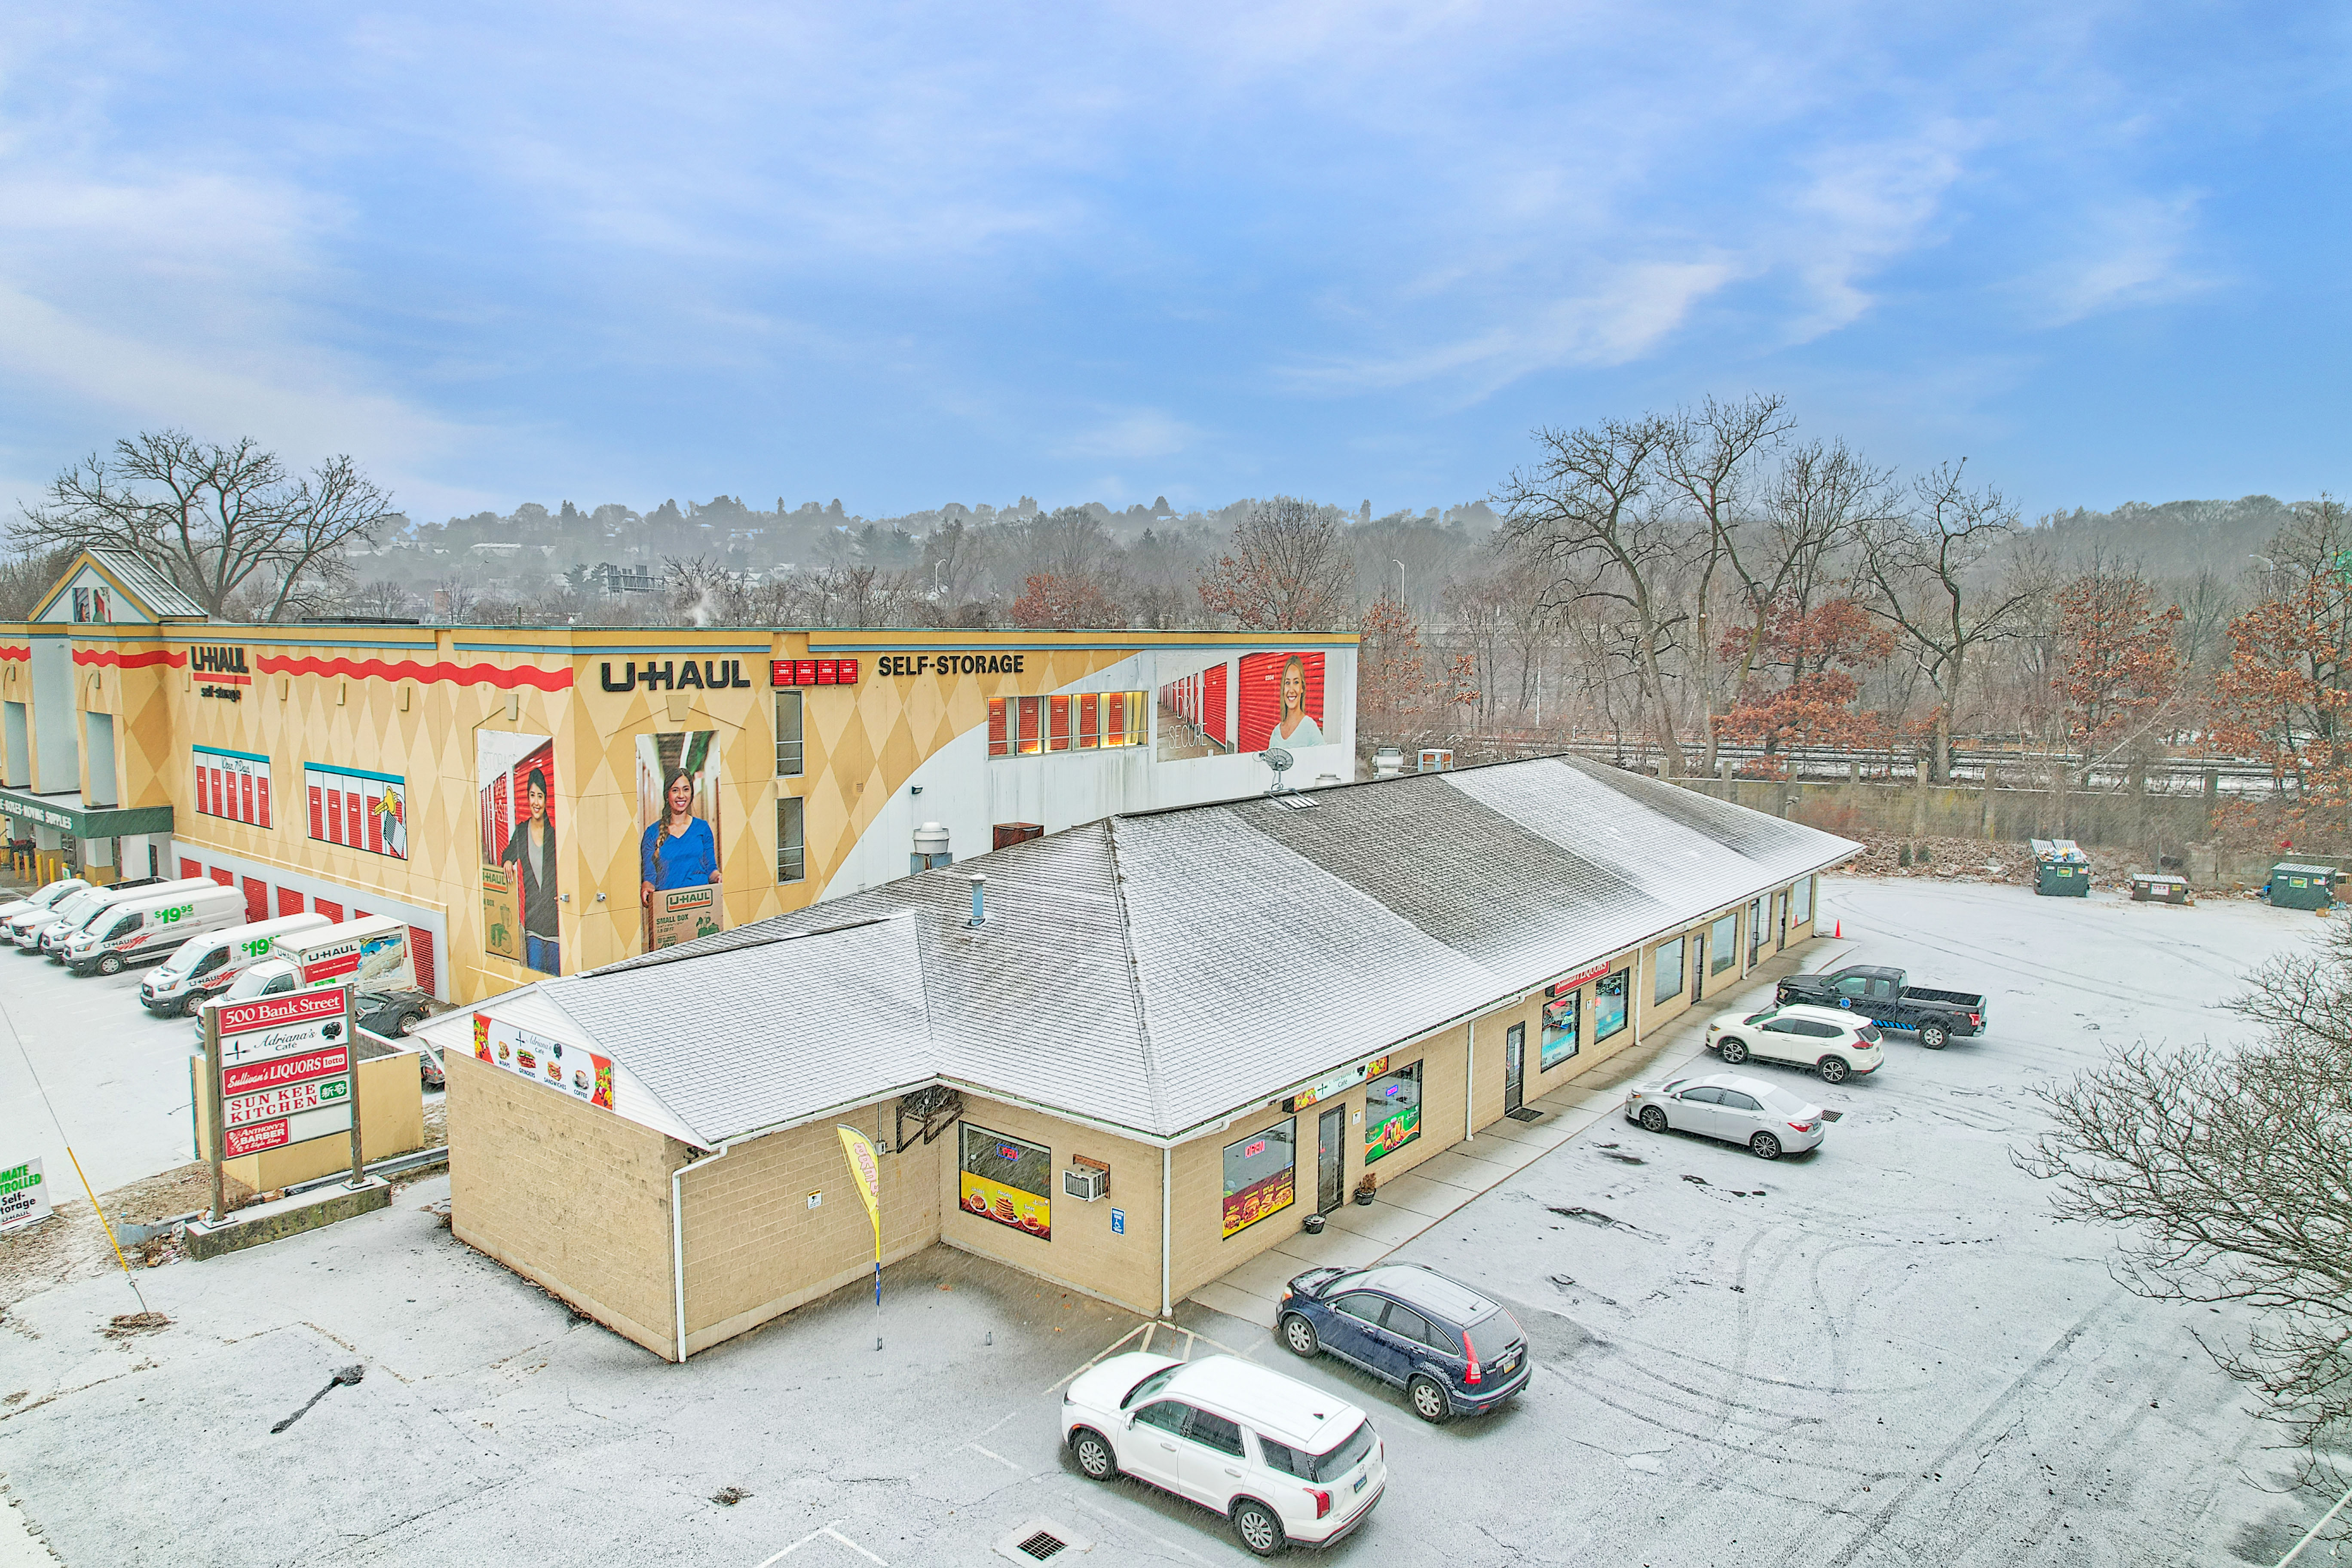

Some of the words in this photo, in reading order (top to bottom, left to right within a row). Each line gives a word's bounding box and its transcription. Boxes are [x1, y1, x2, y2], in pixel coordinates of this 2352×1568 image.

[191, 646, 249, 674] U-HAUL
[879, 655, 1024, 676] SELF-STORAGE
[602, 660, 750, 692] U-HAUL
[1169, 723, 1207, 749] SECURE
[45, 811, 73, 830] SUPPLIES
[670, 892, 710, 905] U-HAUL
[656, 916, 675, 925] SMALL
[103, 938, 134, 949] U-HAUL
[277, 949, 297, 963] U-HAUL
[308, 944, 357, 962] U-HAUL
[189, 975, 221, 986] U-HAUL
[225, 1008, 255, 1025] 500
[258, 1001, 298, 1019] Bank
[300, 996, 340, 1011] Street
[254, 1029, 317, 1048] Adriana's
[526, 1035, 552, 1051] Adriana's
[276, 1042, 297, 1051] Café
[227, 1068, 269, 1088] Sullivan's
[270, 1057, 321, 1079] LIQUORS
[325, 1057, 343, 1066] lotto
[519, 1068, 535, 1078] GRINDERS
[321, 1083, 346, 1098] 新奇
[544, 1077, 567, 1090] SANDWICHES
[1338, 1079, 1348, 1087] Café
[232, 1093, 270, 1111] SUN
[278, 1084, 315, 1101] KEE
[574, 1089, 588, 1099] COFFEE
[230, 1095, 318, 1124] KITCHEN
[240, 1128, 285, 1145] BARBER
[999, 1145, 1017, 1160] PEN
[1245, 1142, 1265, 1158] OPEN
[2, 1191, 25, 1206] Self-
[2, 1210, 30, 1222] U-HAUL
